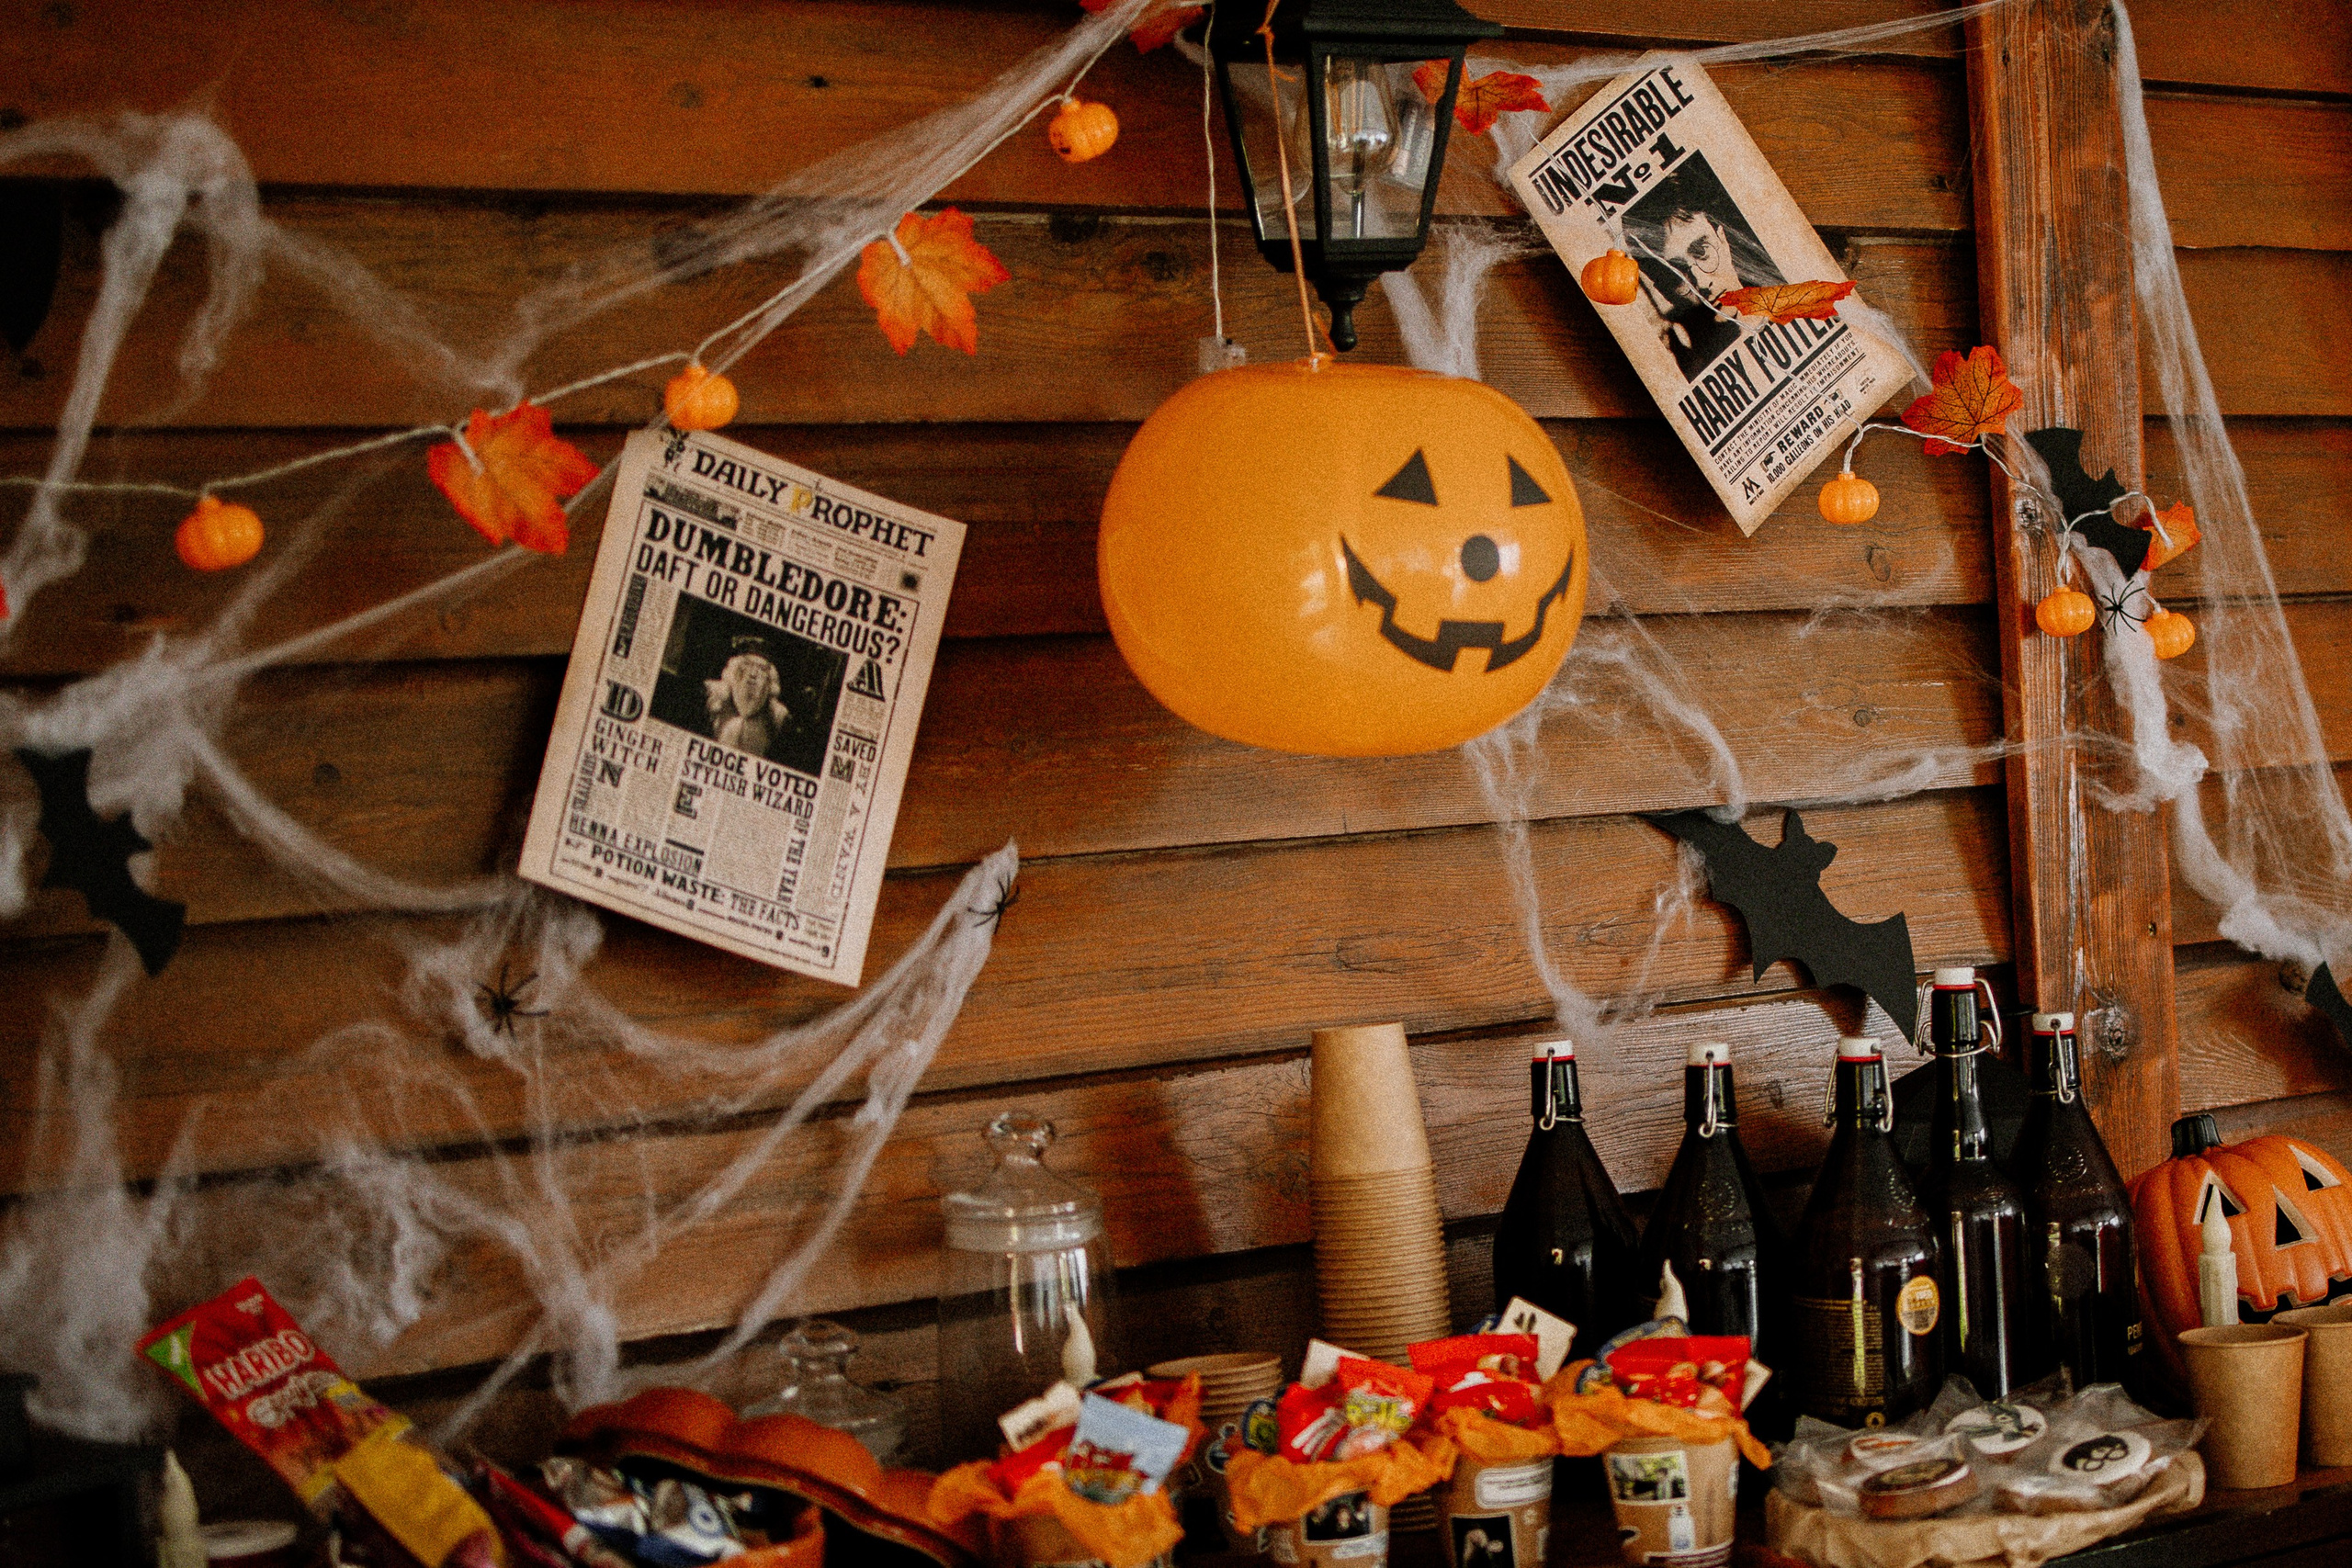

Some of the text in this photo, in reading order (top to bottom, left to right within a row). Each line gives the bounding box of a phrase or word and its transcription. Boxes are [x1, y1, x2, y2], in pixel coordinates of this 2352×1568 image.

[1529, 62, 1696, 220] UNDESIRABLE
[1676, 347, 1765, 447] HARRY
[1713, 330, 1853, 465] CONTACT THE MINISTRY OF MAGIC MMEDIATELY IF YOU
[1717, 455, 1734, 472] HAVE
[1731, 444, 1744, 459] ANY
[1741, 412, 1777, 449] INFORMATION
[1774, 383, 1808, 417] CONCERNING
[1805, 374, 1817, 387] HIS
[1722, 455, 1746, 479] FAILING
[1744, 446, 1754, 458] TO
[1751, 427, 1774, 450] REPORT
[1772, 413, 1788, 430] WILL
[1786, 392, 1810, 416] RESULT
[1774, 403, 1826, 455] REWARD
[1782, 433, 1815, 467] GALLEONS
[1811, 423, 1824, 439] ON
[1820, 412, 1836, 430] HIS
[689, 447, 789, 507] DAILY
[787, 483, 935, 564] PROPHET
[635, 541, 901, 667] DAFT OR DANGEROUS?
[642, 507, 910, 637] DUMBLEDORE:
[590, 734, 659, 773] WITCH
[593, 716, 662, 755] GINGER
[685, 737, 820, 801] FUDGE VOTED
[832, 732, 877, 764] SAVED
[680, 757, 815, 821] STYLISH WIZARD
[568, 812, 620, 846] HENNA
[621, 831, 703, 877] EXPLOSION
[590, 843, 658, 881] POTION
[728, 892, 758, 917] THE
[757, 901, 802, 931] FACTS
[775, 817, 810, 905] OF THE YEAR
